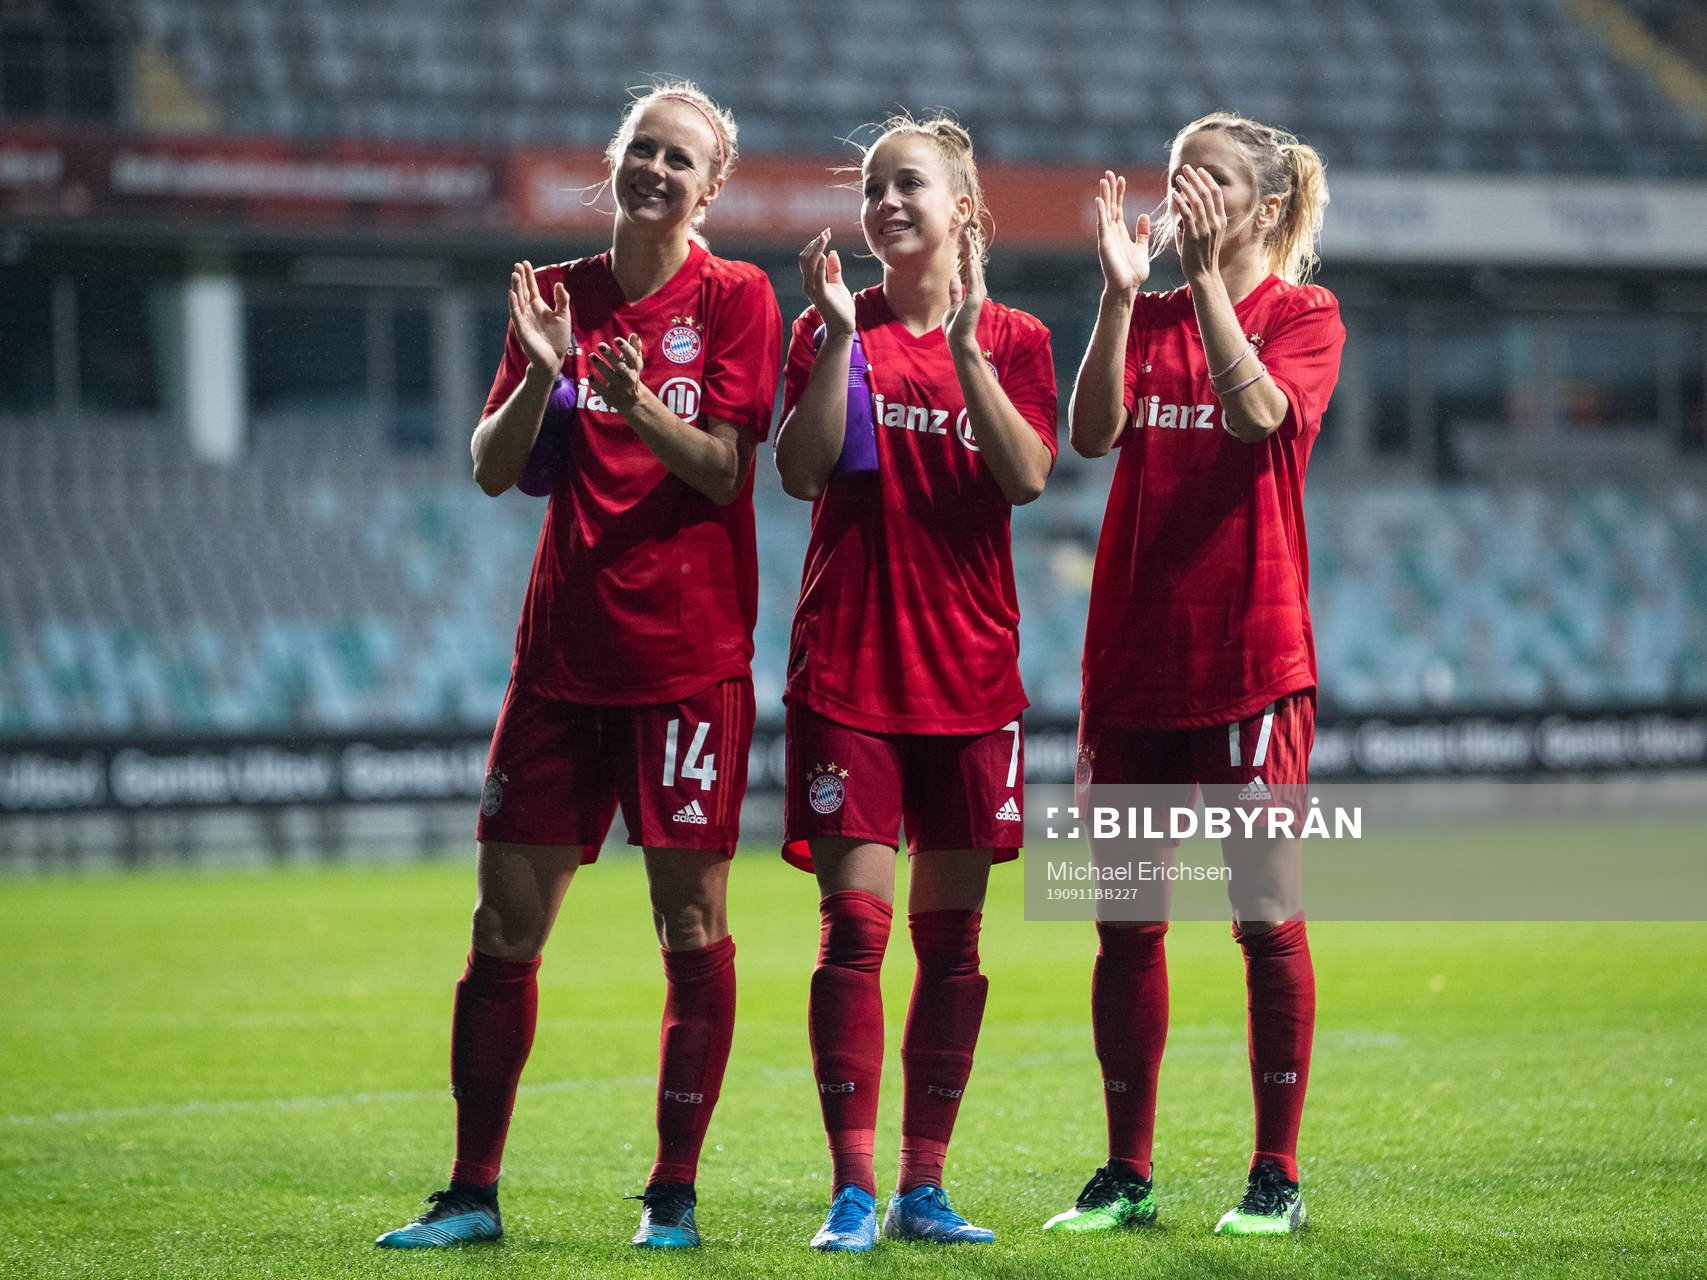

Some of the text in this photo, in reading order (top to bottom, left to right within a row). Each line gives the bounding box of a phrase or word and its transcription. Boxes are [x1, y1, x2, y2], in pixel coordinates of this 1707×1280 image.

[662, 718, 717, 791] 14
[1001, 720, 1020, 788] 7
[1238, 790, 1272, 800] adidas
[672, 813, 708, 825] adidas
[1264, 1071, 1297, 1084] FCB
[820, 1081, 855, 1094] FCB
[927, 1084, 963, 1099] FCB
[664, 1089, 704, 1104] FCB
